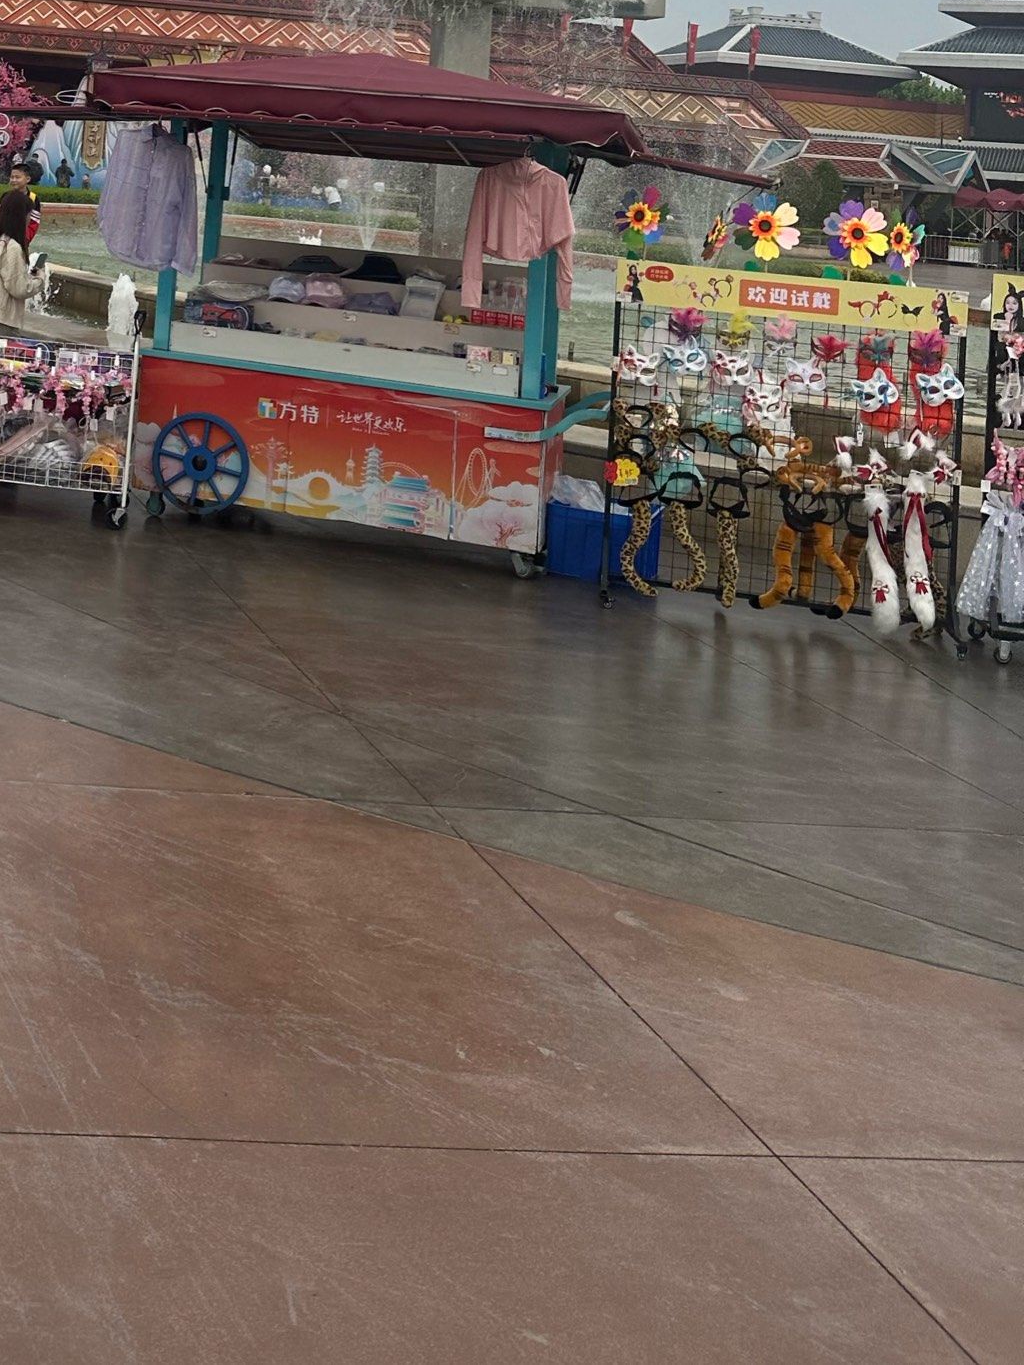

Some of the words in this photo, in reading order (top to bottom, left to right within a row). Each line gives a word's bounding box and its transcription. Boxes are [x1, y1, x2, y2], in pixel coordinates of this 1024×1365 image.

[747, 286, 832, 309] 欢迎试戴
[279, 401, 320, 425] 方特
